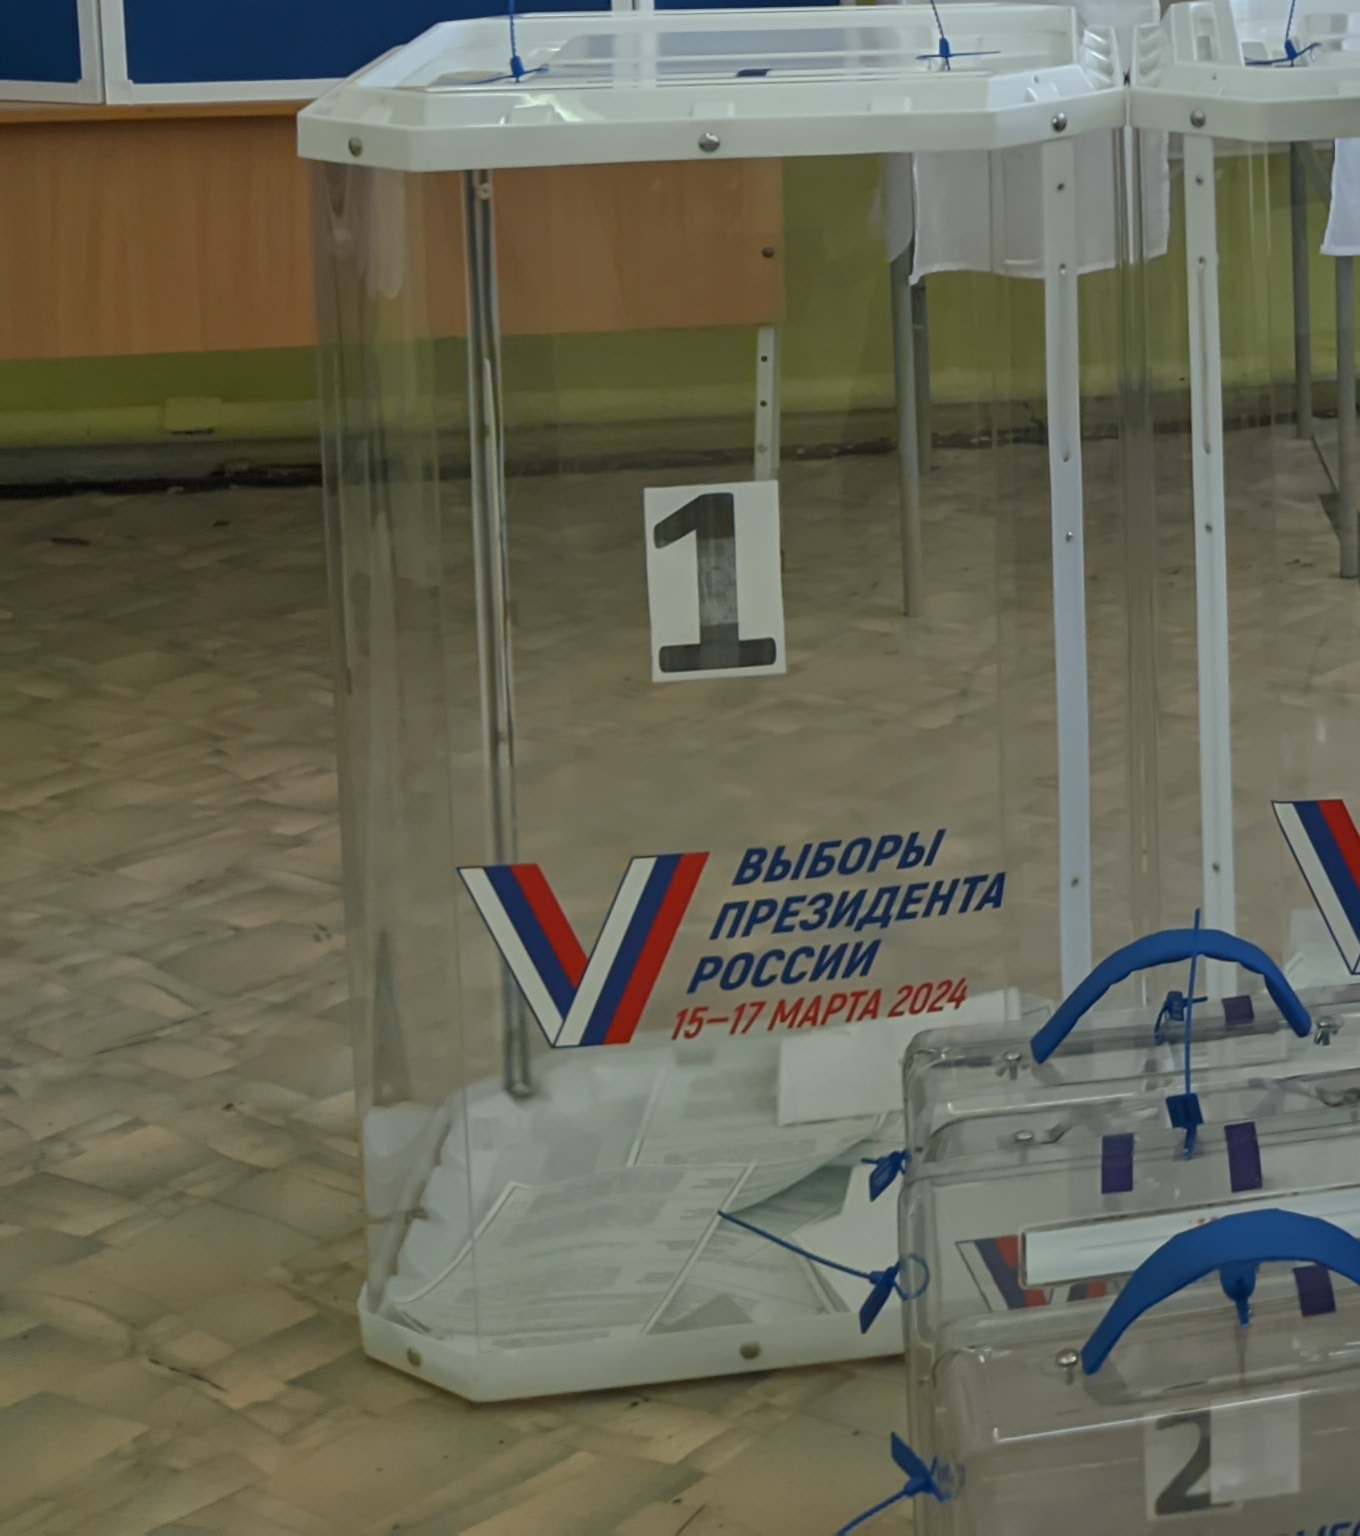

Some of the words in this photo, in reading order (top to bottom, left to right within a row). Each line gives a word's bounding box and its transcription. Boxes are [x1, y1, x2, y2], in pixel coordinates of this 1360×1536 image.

[653, 491, 777, 673] 1
[732, 828, 947, 886] ВЫБОРЫ
[708, 871, 1007, 941] ПРЕЗИДЕНТА
[686, 938, 882, 995] РОССИИ
[767, 988, 882, 1032] МАРТА
[887, 976, 969, 1019] 2024
